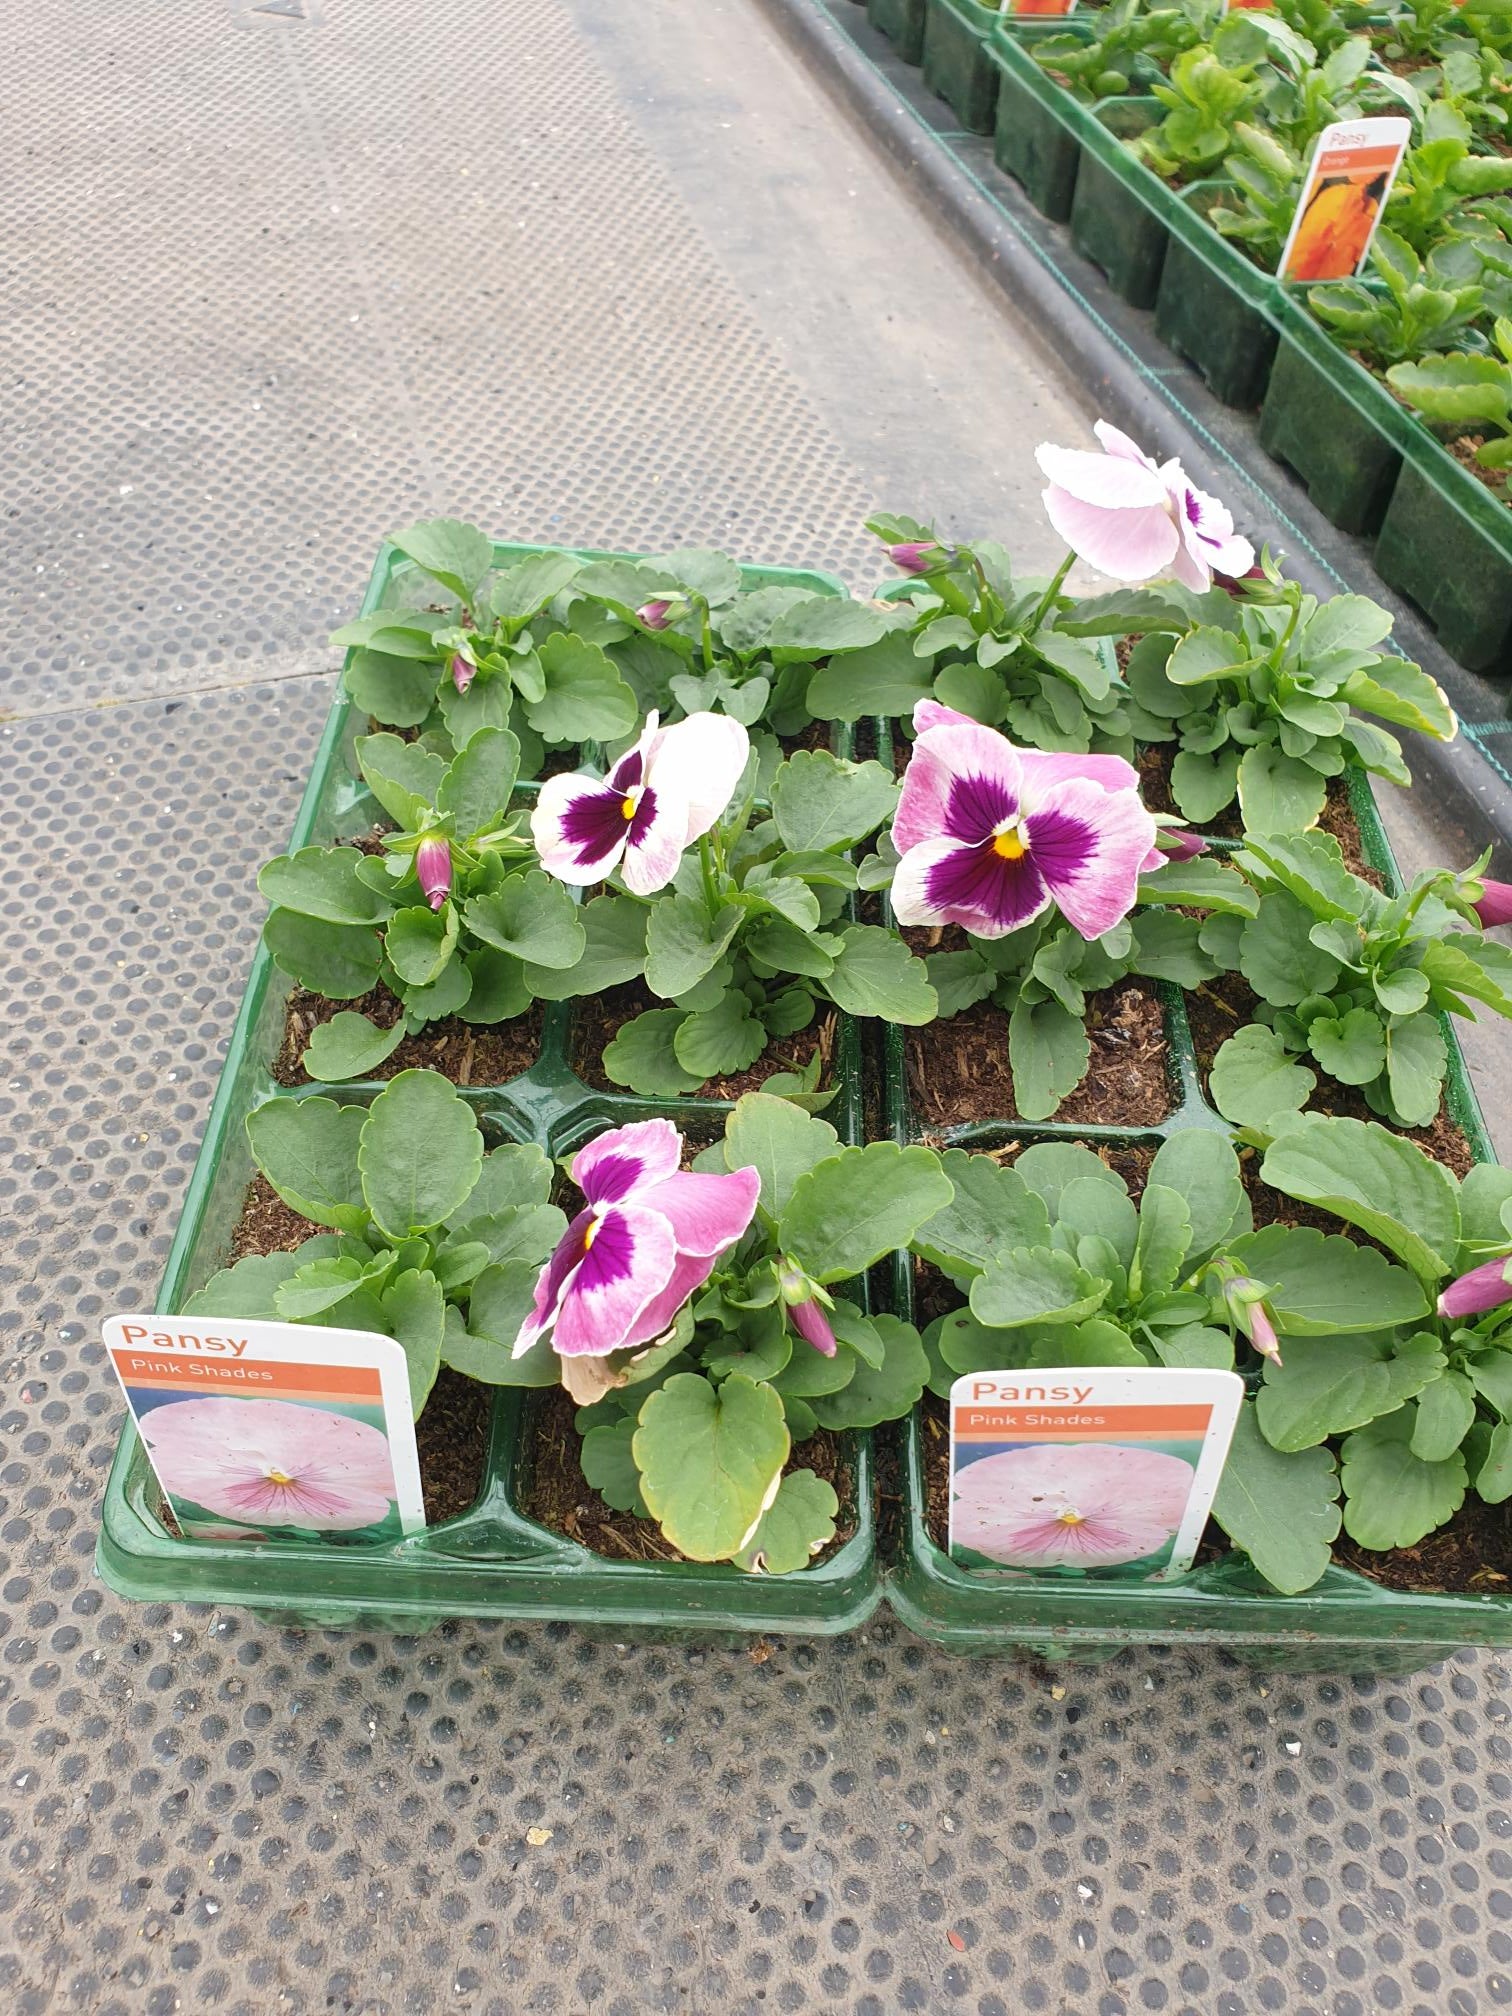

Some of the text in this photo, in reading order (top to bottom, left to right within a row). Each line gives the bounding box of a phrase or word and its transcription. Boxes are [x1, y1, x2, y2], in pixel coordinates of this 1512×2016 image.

[1330, 132, 1368, 147] Pansy
[121, 1324, 249, 1357] Pansy
[131, 1358, 273, 1381] Pink Shades
[972, 1382, 1095, 1405] Pansy
[970, 1413, 1106, 1426] Pink Shades
